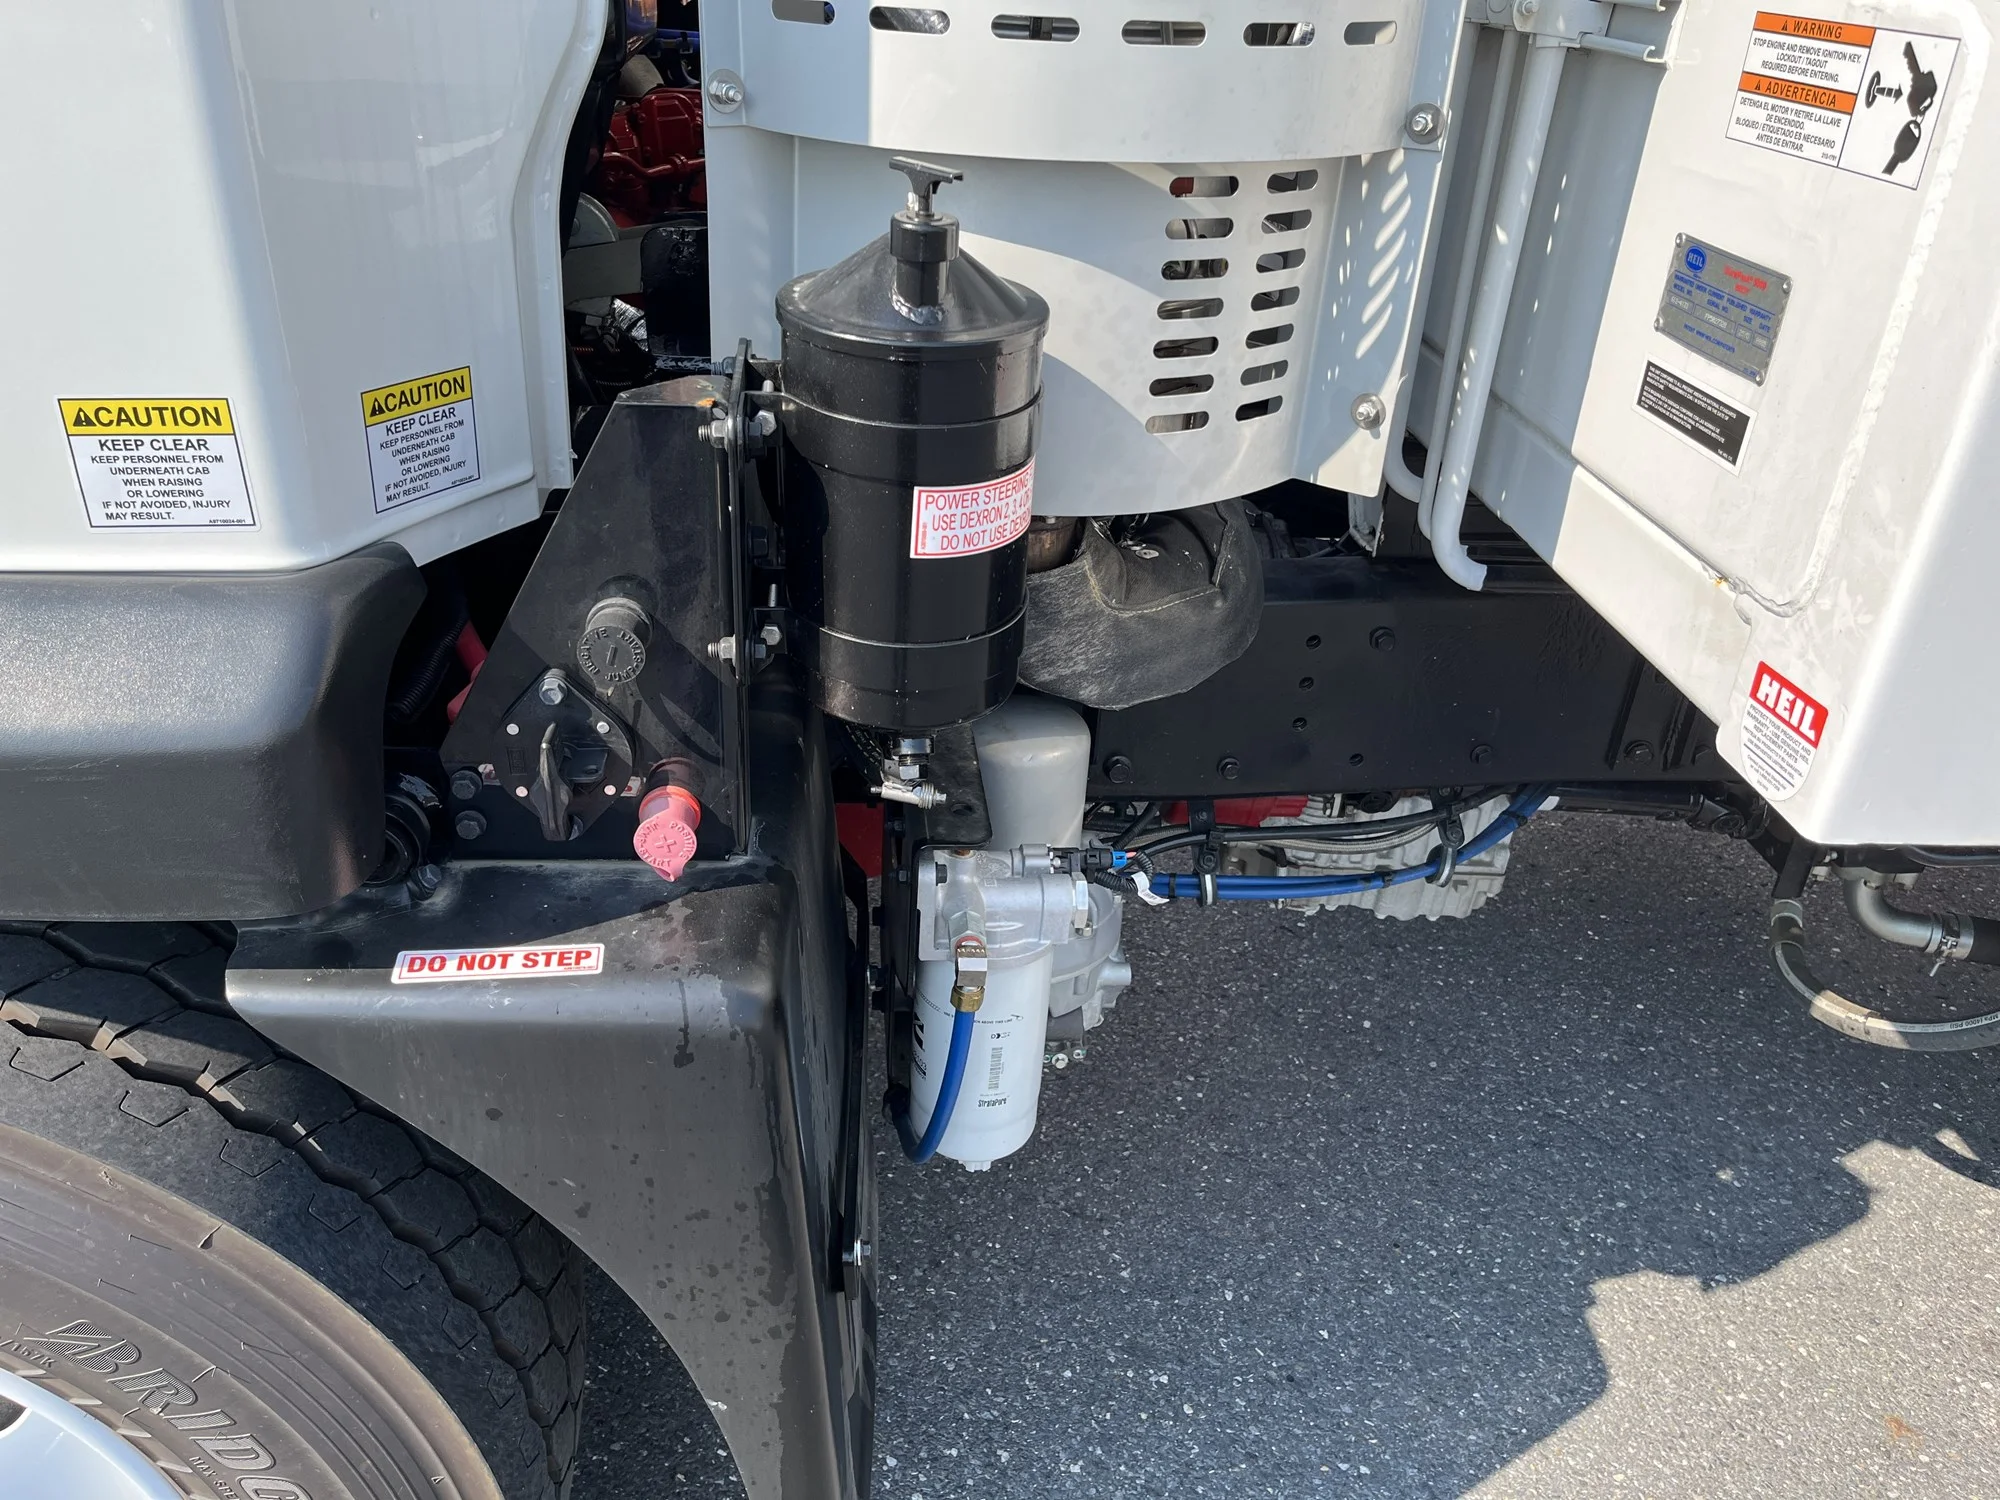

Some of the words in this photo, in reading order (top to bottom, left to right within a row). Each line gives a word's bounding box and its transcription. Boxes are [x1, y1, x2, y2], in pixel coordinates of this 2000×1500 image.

[1791, 20, 1843, 39] WARNING
[1752, 37, 1766, 47] STOP
[1766, 40, 1786, 50] ENGINE
[1785, 43, 1798, 52] AND
[1797, 45, 1821, 56] REMOVE
[1821, 49, 1847, 60] IGNITION
[1776, 52, 1801, 64] LOCKOUT
[1804, 57, 1827, 68] TAGOUT
[1760, 60, 1787, 72] REQUIRED
[1786, 65, 1809, 76] BEFORE
[1764, 80, 1838, 107] ADVERTENCIA
[1739, 96, 1763, 109] DETENGA
[1762, 101, 1770, 110] EL
[1769, 103, 1790, 115] MOTOR
[1789, 107, 1794, 116] Y
[1793, 108, 1814, 120] RETIRE
[1813, 113, 1822, 122] LA
[1821, 115, 1841, 127] LLAVE
[1765, 113, 1773, 122] DE
[1735, 116, 1759, 129] BLOQUEO
[1761, 123, 1794, 138] ETIQUETADO
[1793, 131, 1802, 140] ES
[1801, 133, 1836, 148] NECESARIO
[1755, 132, 1773, 144] ANTES
[1772, 137, 1781, 146] DE
[1686, 252, 1704, 267] HEIL
[384, 375, 466, 412] CAUTION
[92, 406, 222, 426] CAUTION
[385, 417, 416, 436] KEEP
[418, 406, 456, 427] CLEAR
[97, 439, 145, 450] KEEP
[149, 438, 209, 450] CLEAR
[379, 437, 399, 450] KEEP
[400, 425, 442, 444] PERSONNEL
[444, 419, 464, 432] FROM
[391, 436, 438, 457] UNDERNEATH
[440, 432, 455, 443] CAB
[399, 452, 420, 466] WHEN
[421, 444, 450, 459] RAISING
[401, 466, 411, 476] OR
[413, 454, 450, 472] LOWERING
[384, 483, 390, 492] IF
[392, 478, 407, 489] NOT
[409, 467, 441, 484] AVOIDED,
[442, 460, 466, 474] INJURY
[385, 491, 401, 502] MAY
[402, 481, 430, 497] RESULT.
[925, 491, 980, 511] POWER
[983, 471, 1029, 505] STEERING
[139, 500, 191, 509] AVOIDED,
[933, 513, 957, 531] USE
[960, 504, 1003, 530] DEXRON
[941, 534, 960, 550] DO
[963, 529, 988, 549] NOT
[989, 522, 1009, 543] USE
[1756, 672, 1816, 742] HEIL
[1749, 703, 1768, 722] PROTECT
[1768, 718, 1780, 731] YOUR
[1779, 728, 1802, 748] PRODUCT
[1800, 744, 1811, 756] AND
[1752, 723, 1784, 751] REPLACEMENT
[1782, 748, 1798, 763] PARTS
[406, 955, 447, 973] DO
[456, 952, 514, 971] NOT
[520, 949, 592, 968] STEP
[189, 1456, 218, 1478] MAX
